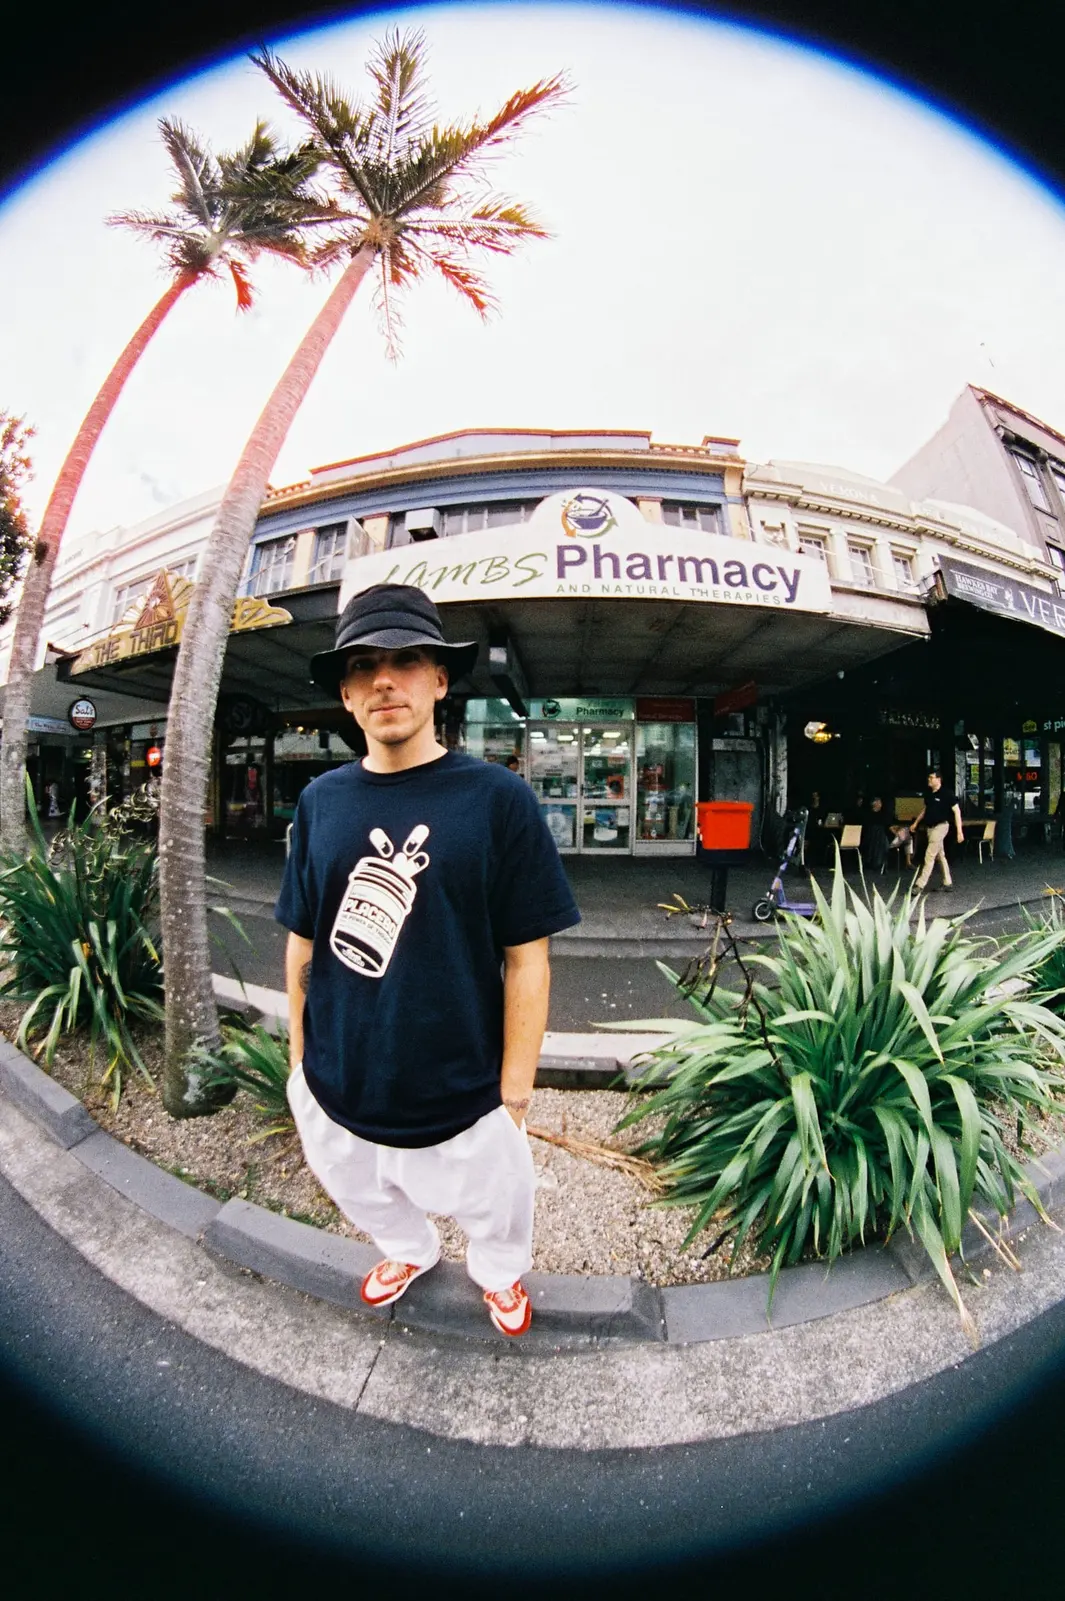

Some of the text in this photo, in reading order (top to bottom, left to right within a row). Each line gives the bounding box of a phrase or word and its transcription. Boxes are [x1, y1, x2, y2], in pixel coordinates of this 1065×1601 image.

[556, 543, 801, 603] Pharmacy
[556, 583, 781, 606] AND NATURAL THERAPIES
[94, 620, 178, 663] THE THIRD
[576, 706, 624, 718] Pharmacy
[1043, 719, 1052, 731] st
[344, 898, 397, 938] PLACEBO
